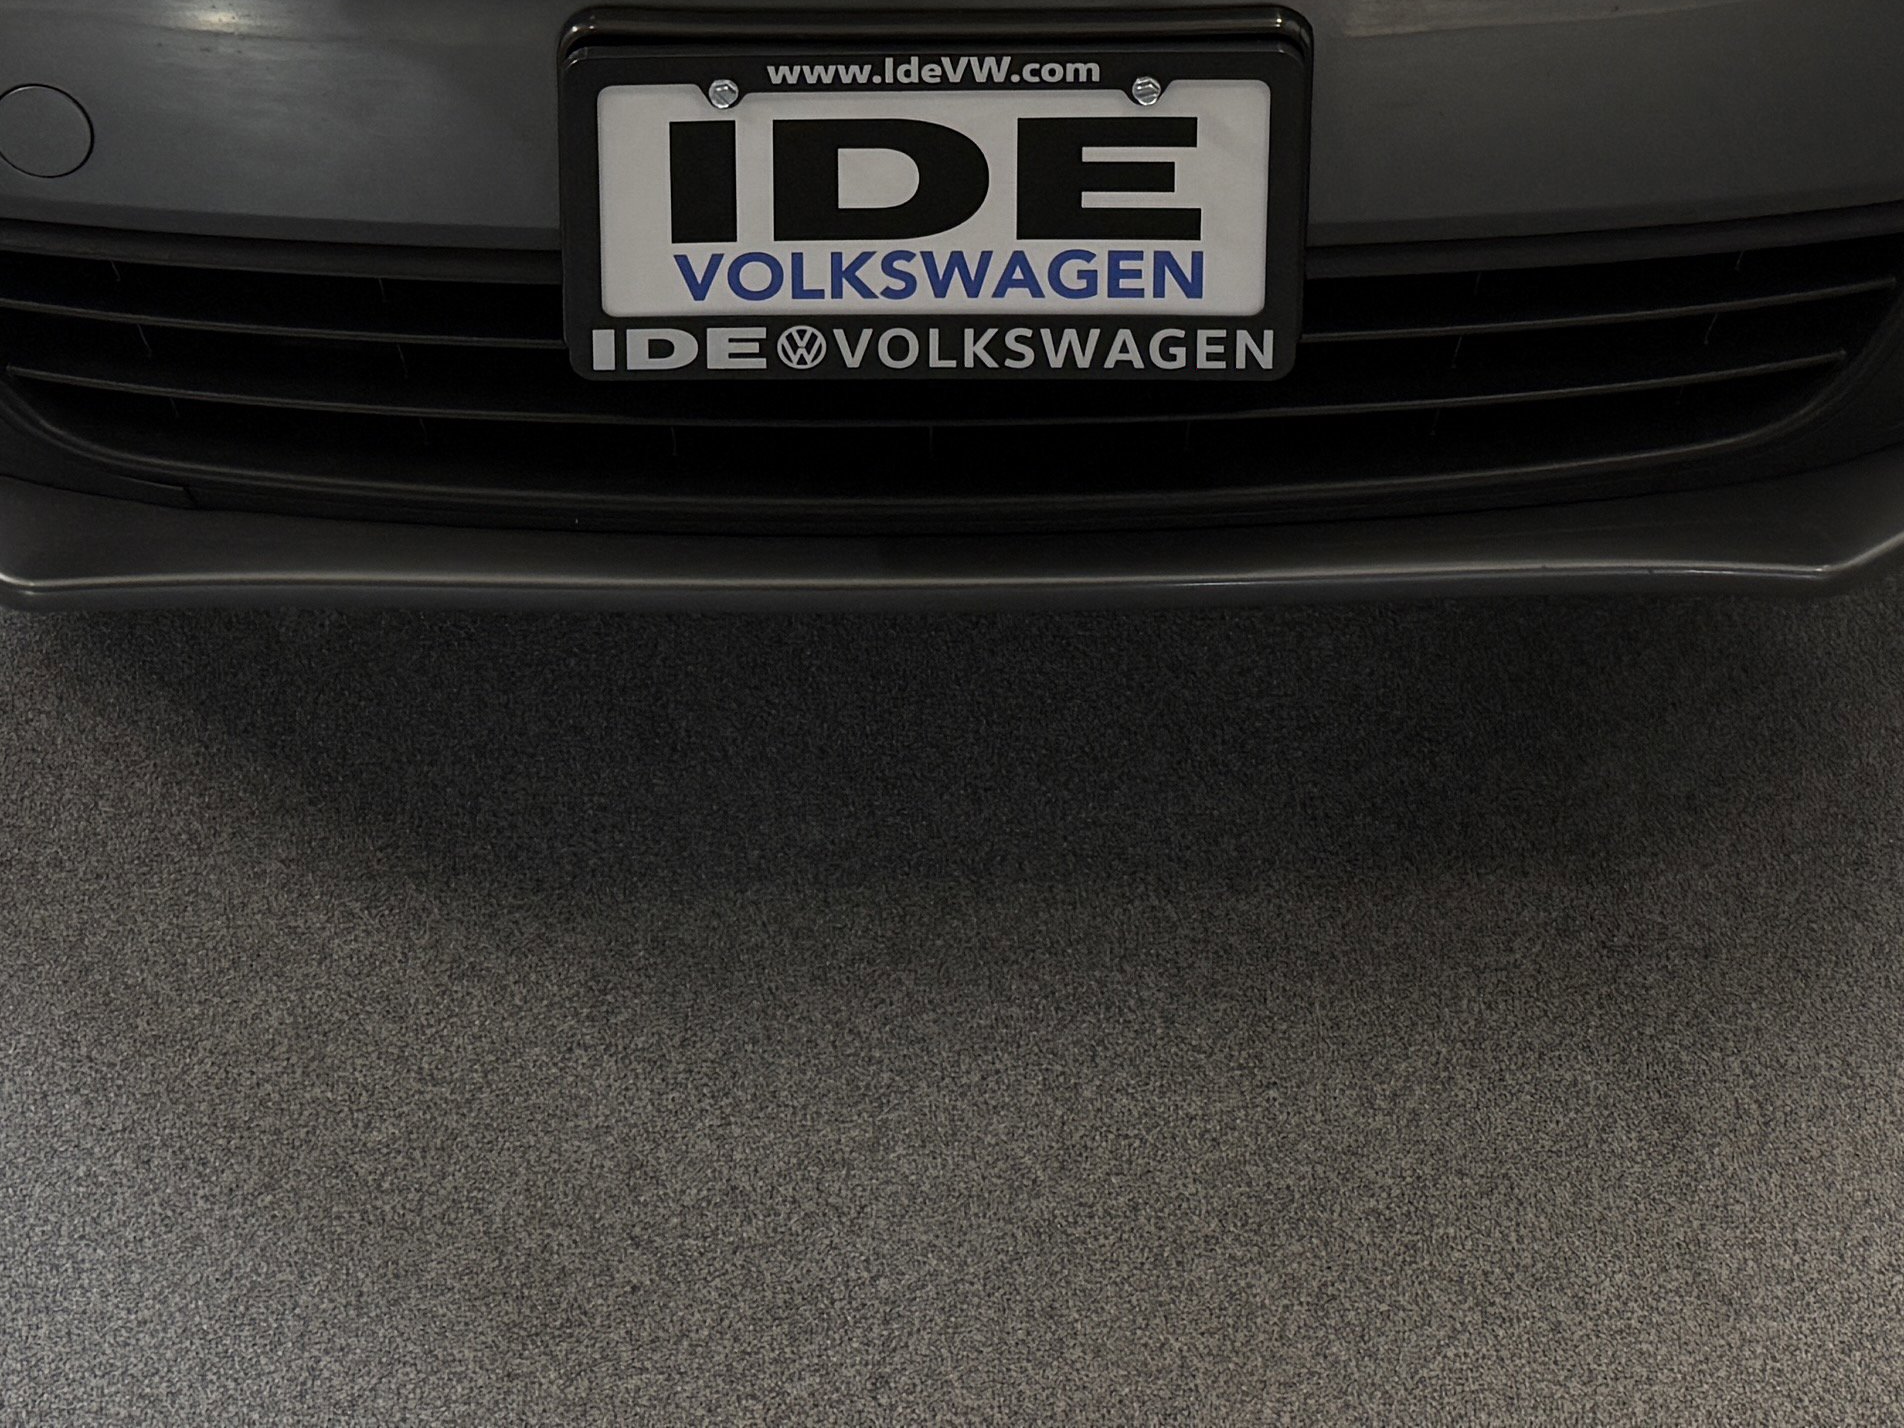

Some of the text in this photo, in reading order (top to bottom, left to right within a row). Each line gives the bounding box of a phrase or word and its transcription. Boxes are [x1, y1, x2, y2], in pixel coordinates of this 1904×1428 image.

[766, 56, 1100, 85] www.IdeVW.com
[668, 116, 1202, 245] IDE
[672, 249, 1204, 302] VOLKSWAGEN
[592, 328, 767, 371] IDE
[832, 327, 1275, 370] VOLKSWAGEN
